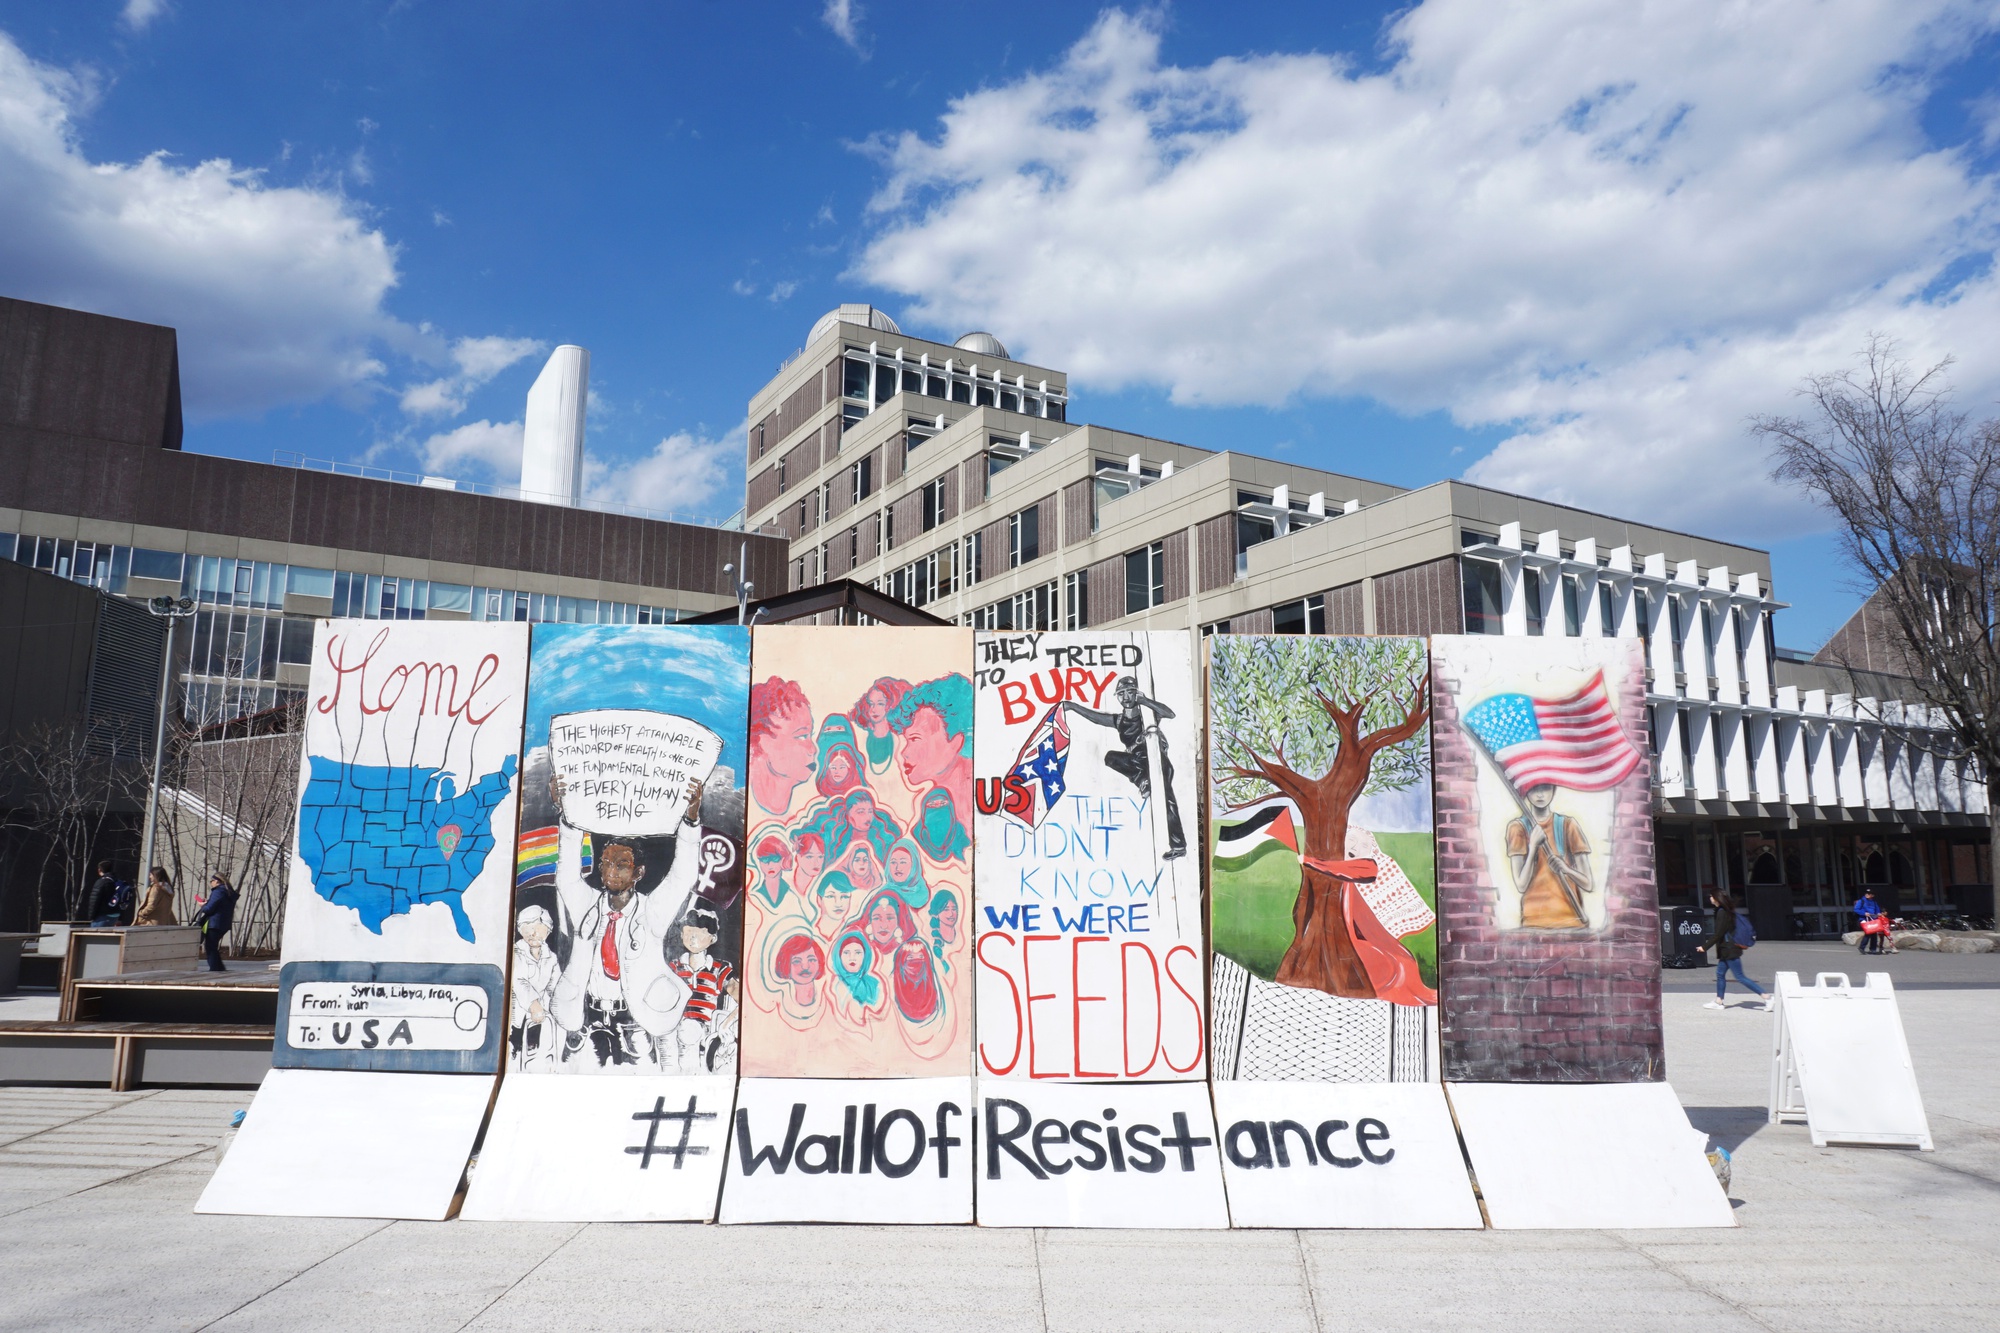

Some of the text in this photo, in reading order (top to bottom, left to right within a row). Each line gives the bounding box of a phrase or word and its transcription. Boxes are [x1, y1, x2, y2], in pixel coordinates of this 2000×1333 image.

[978, 632, 1143, 668] THEY TRIED
[318, 627, 511, 725] Home
[975, 667, 1117, 725] TO BURY
[555, 723, 704, 752] THE HIGHEST ATTAINABLE
[557, 742, 612, 757] STANDARD
[625, 743, 658, 760] HEALTH
[669, 751, 684, 764] ONE
[685, 758, 701, 767] OF
[561, 760, 686, 782] THE FUNDAMENTAL RIGHTS
[569, 779, 680, 808] OF EVERY HUMAN
[976, 775, 1031, 815] US
[596, 800, 652, 823] BEING
[1067, 795, 1148, 830] THEY
[1020, 866, 1164, 901] KNOW
[984, 903, 1150, 934] WE WERE
[301, 994, 341, 1010] From:
[977, 931, 1203, 1079] SEEDS
[300, 1019, 413, 1048] To: USA
